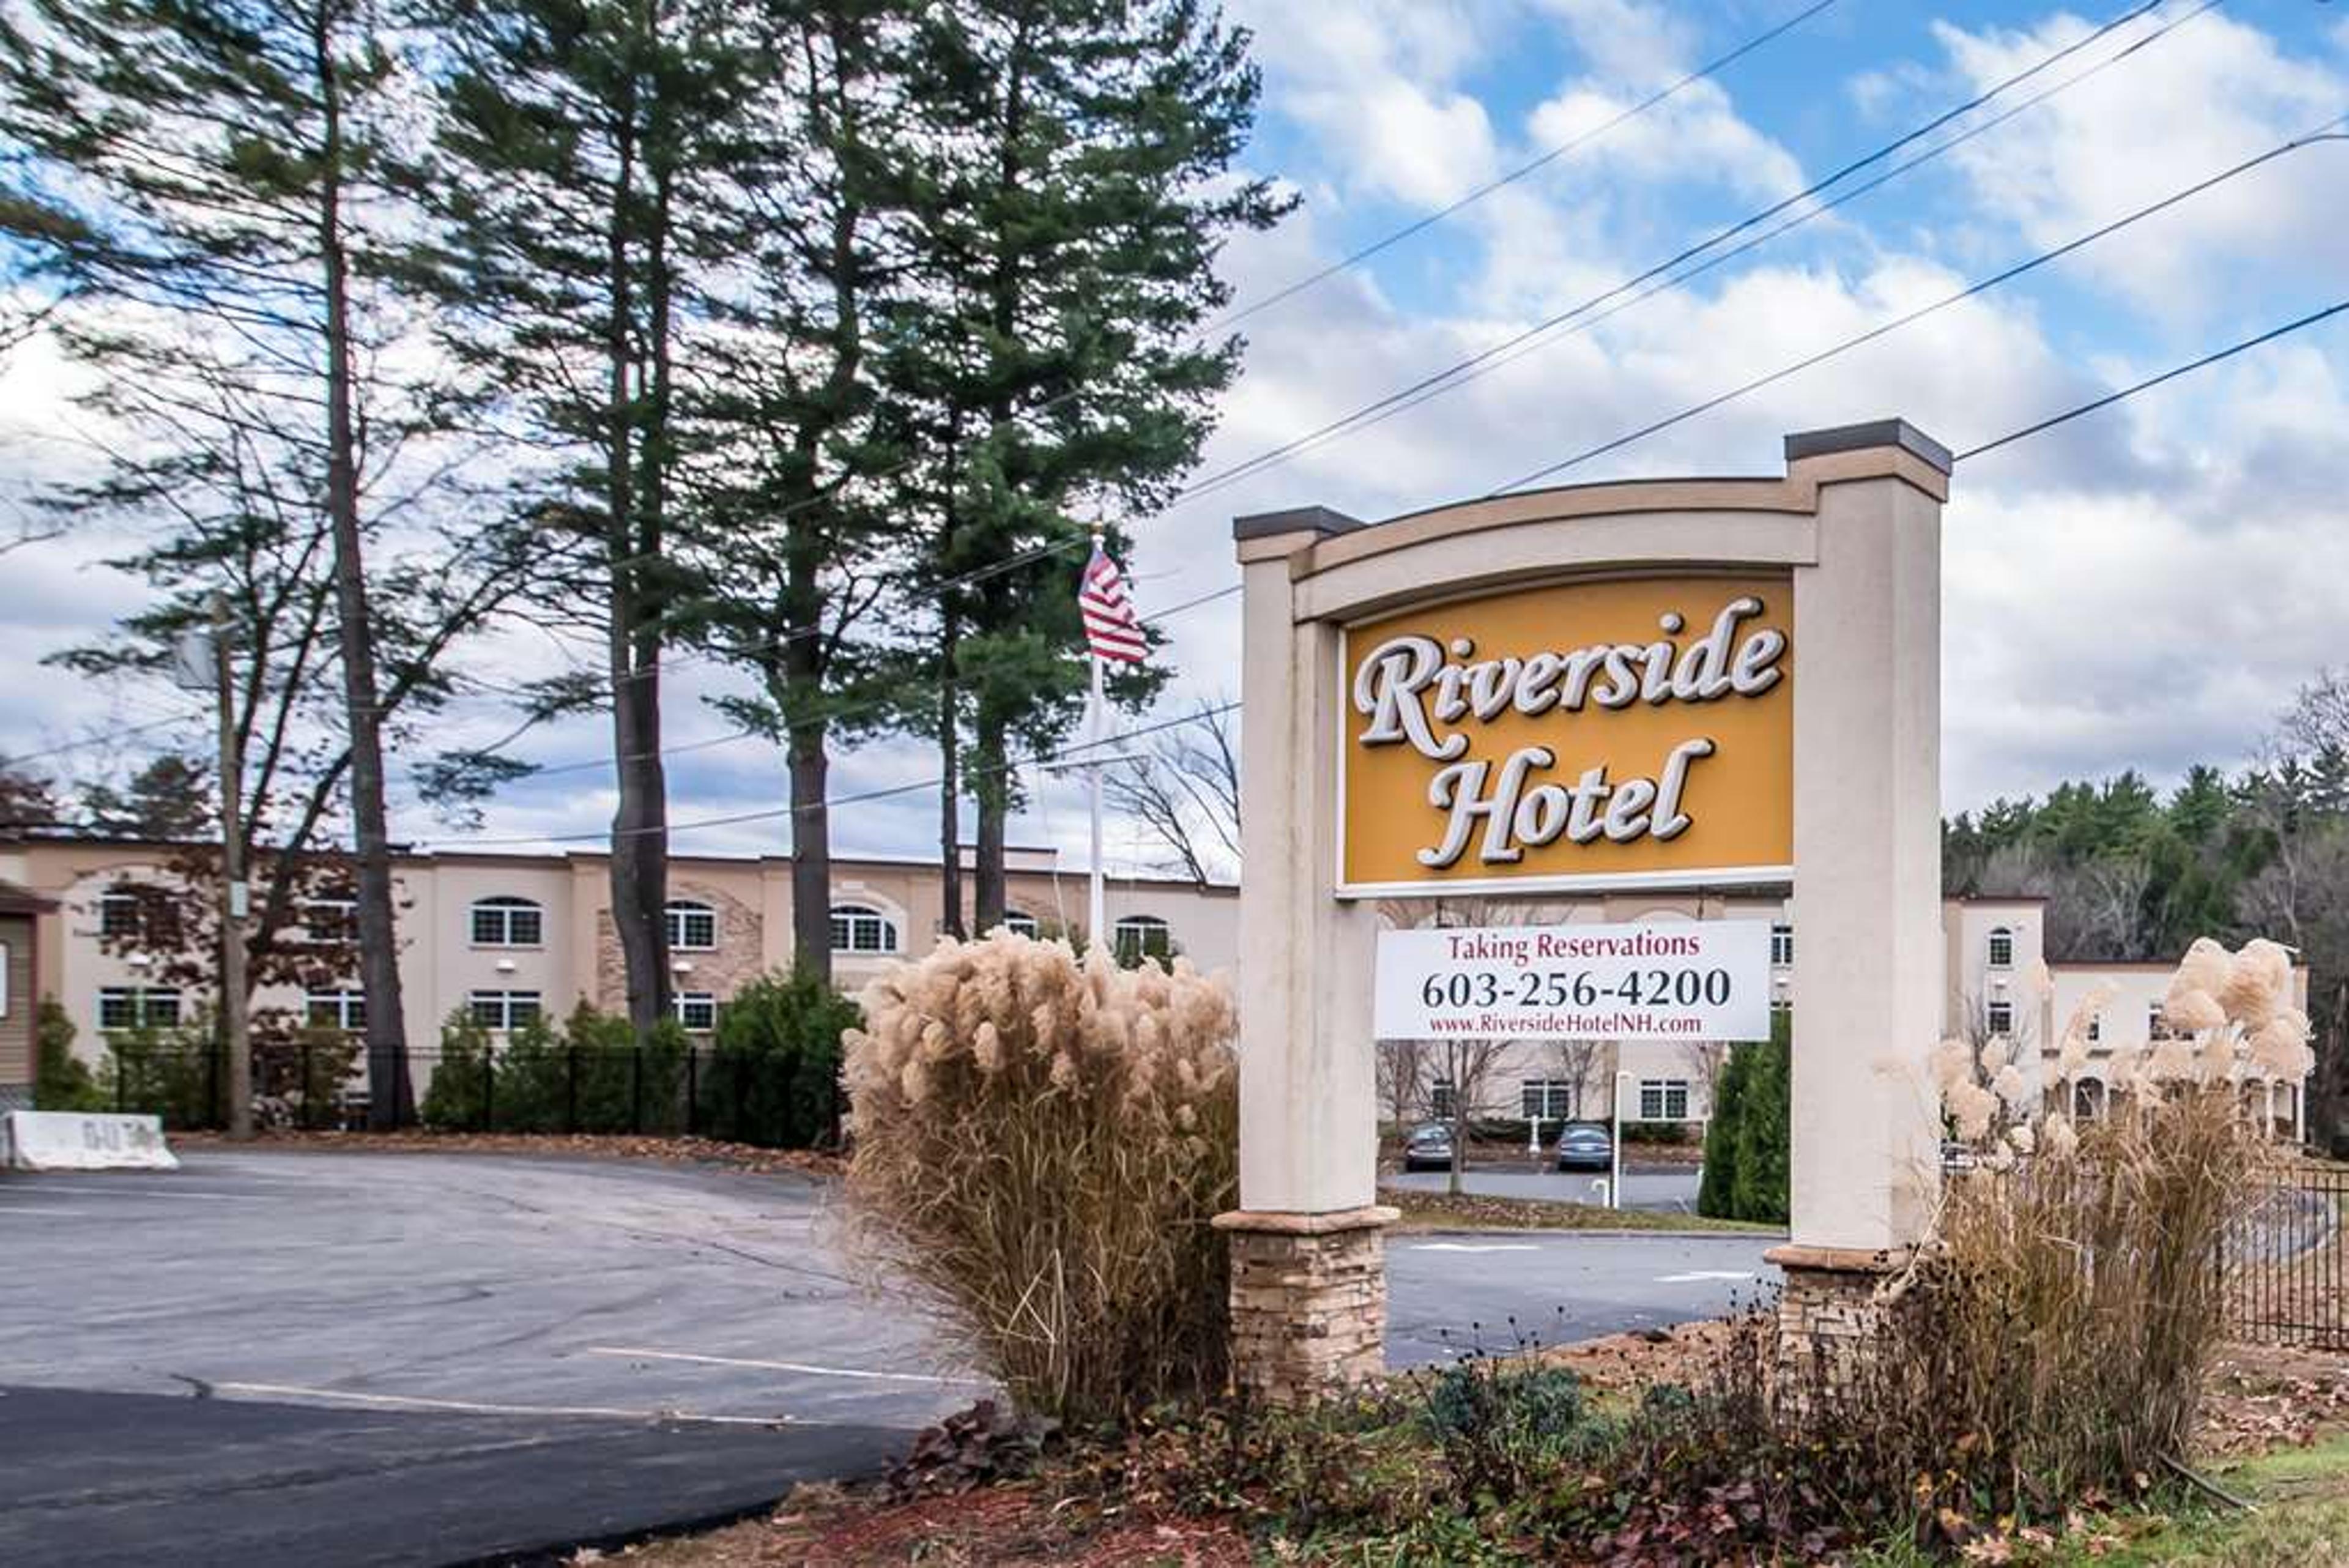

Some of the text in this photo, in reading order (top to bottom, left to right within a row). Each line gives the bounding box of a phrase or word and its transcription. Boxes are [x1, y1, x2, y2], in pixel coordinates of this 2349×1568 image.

[1354, 596, 1787, 760] Riverside
[1416, 738, 1716, 868] Hotel
[1449, 929, 1700, 966] Taking Reservations
[1423, 969, 1731, 1008] 603-256-4200
[1430, 1013, 1701, 1033] www.RiversideHotelNH.com
